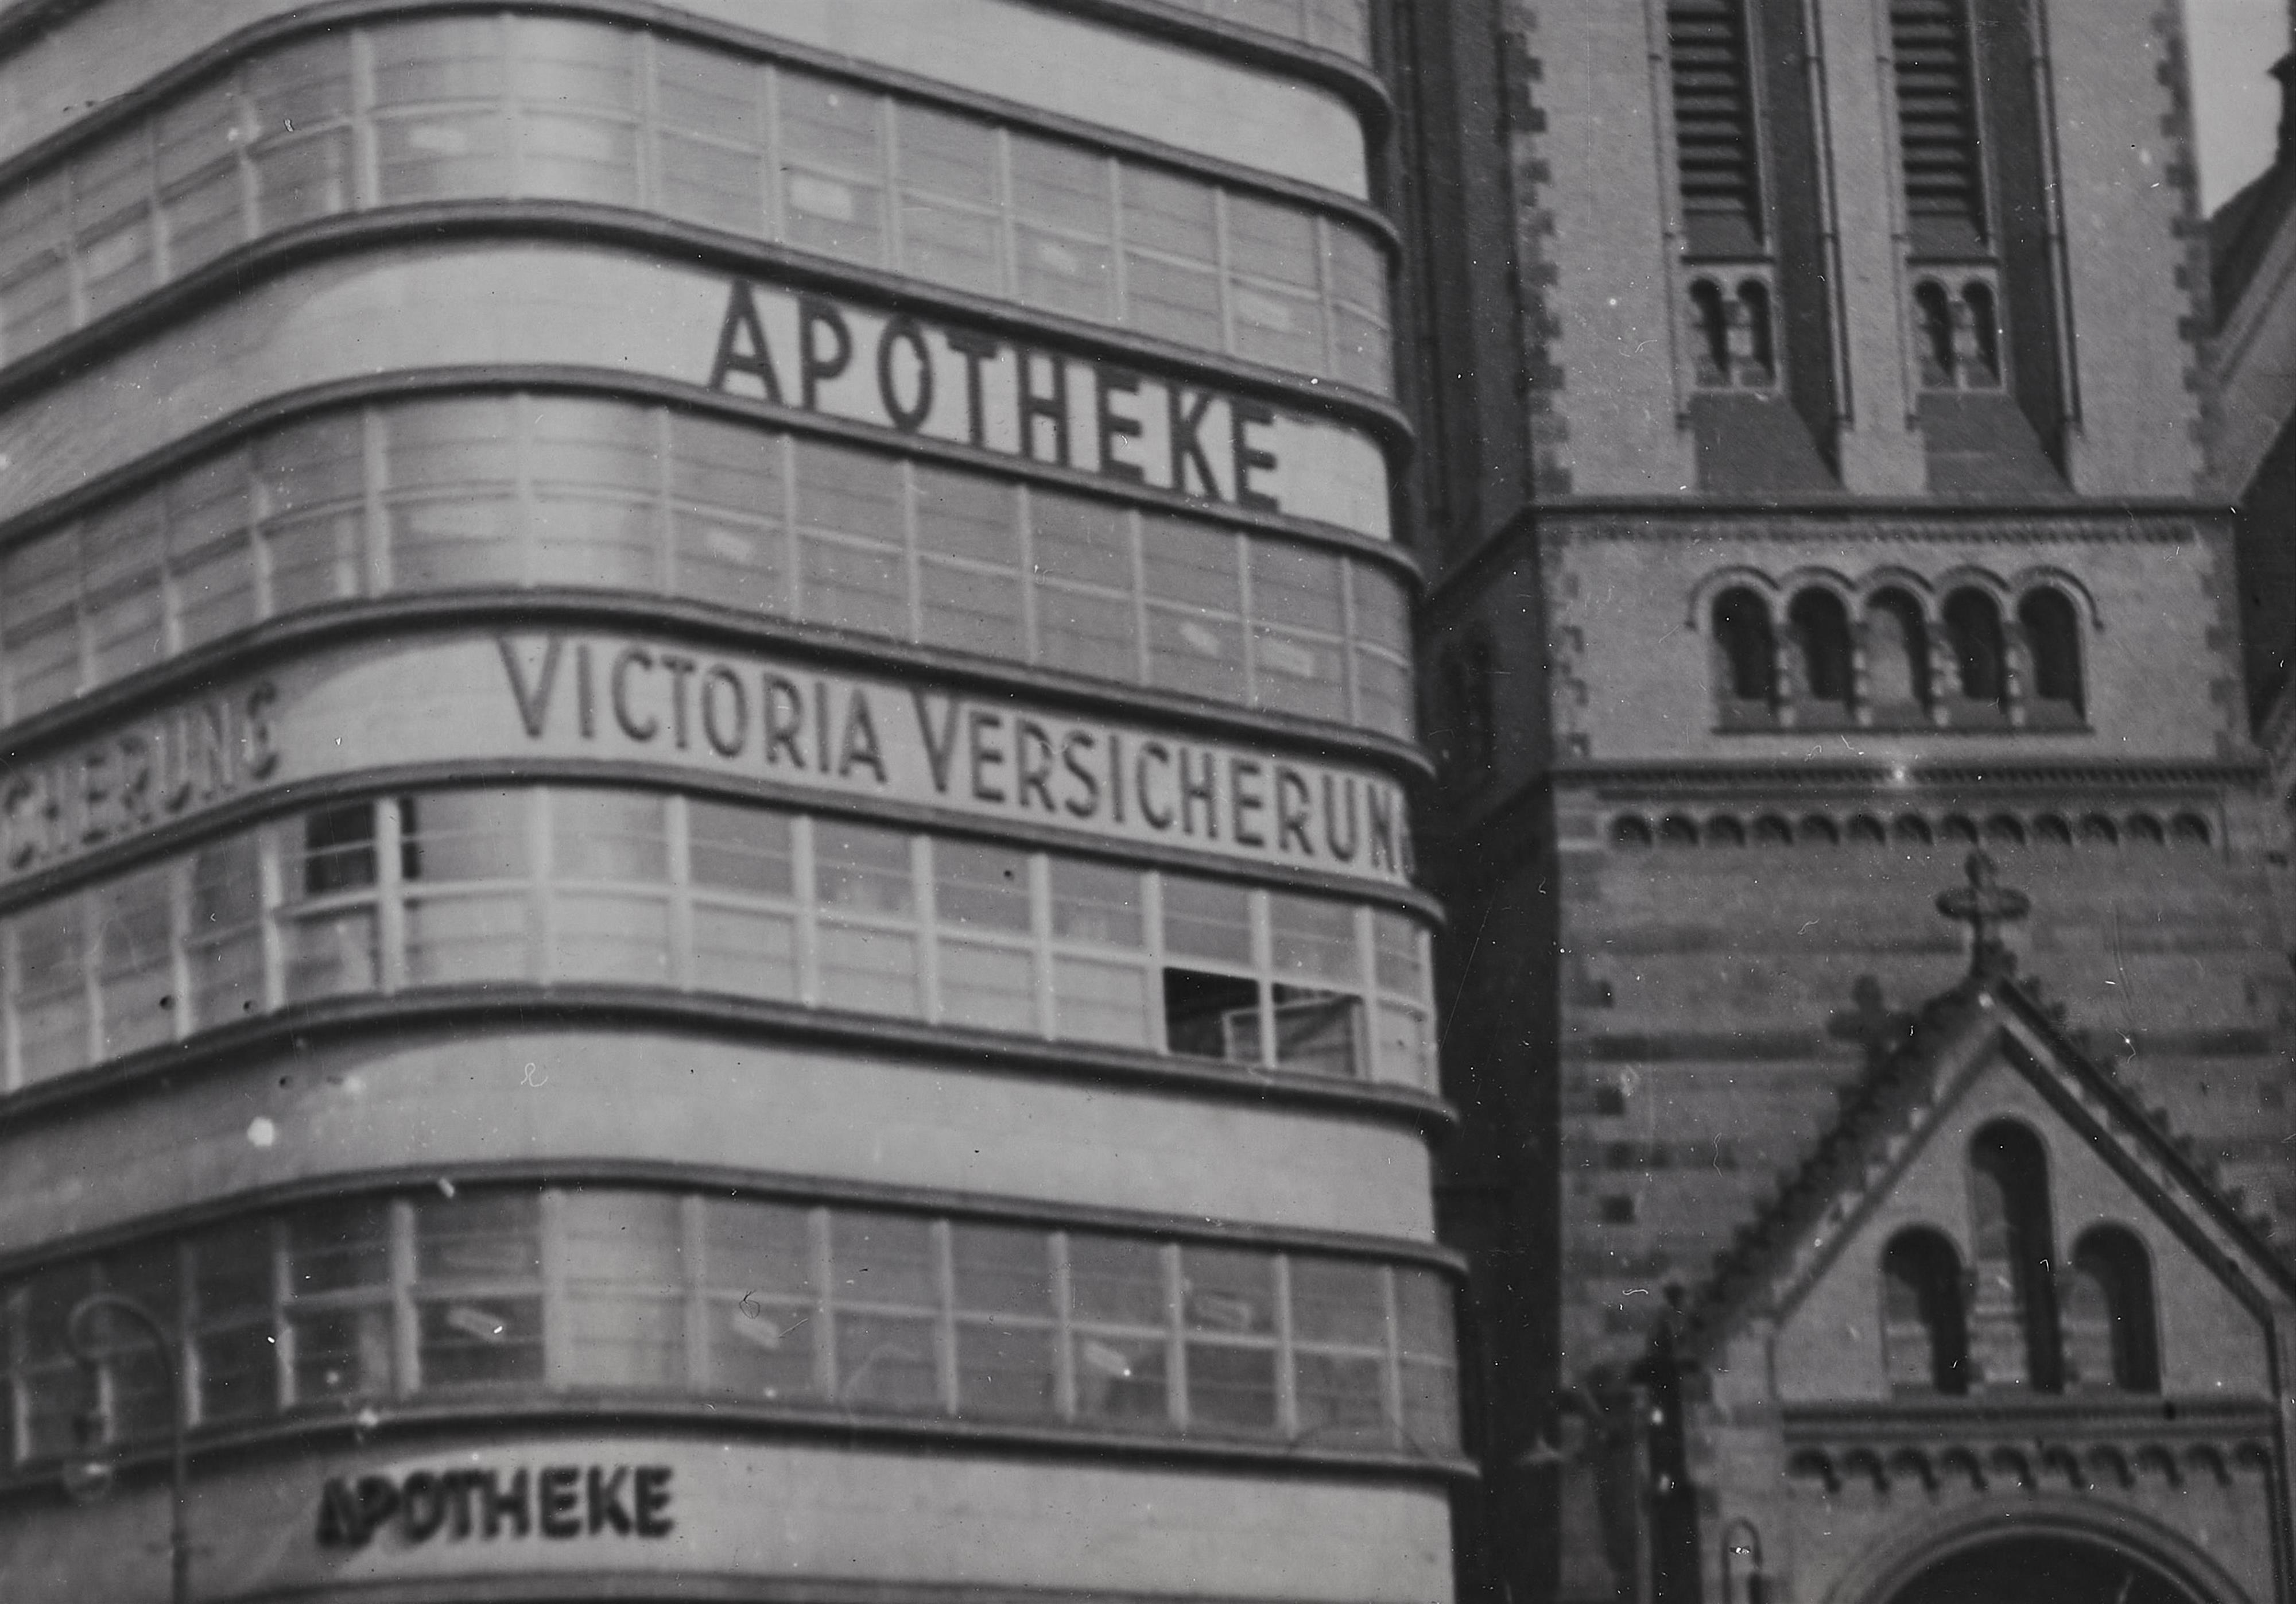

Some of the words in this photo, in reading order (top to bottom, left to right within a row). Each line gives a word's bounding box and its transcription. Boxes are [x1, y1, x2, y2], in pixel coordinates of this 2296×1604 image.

[708, 278, 1279, 512] APOTHEKE
[496, 635, 889, 784] VICTORIA
[315, 1465, 674, 1550] APOTHEKE
